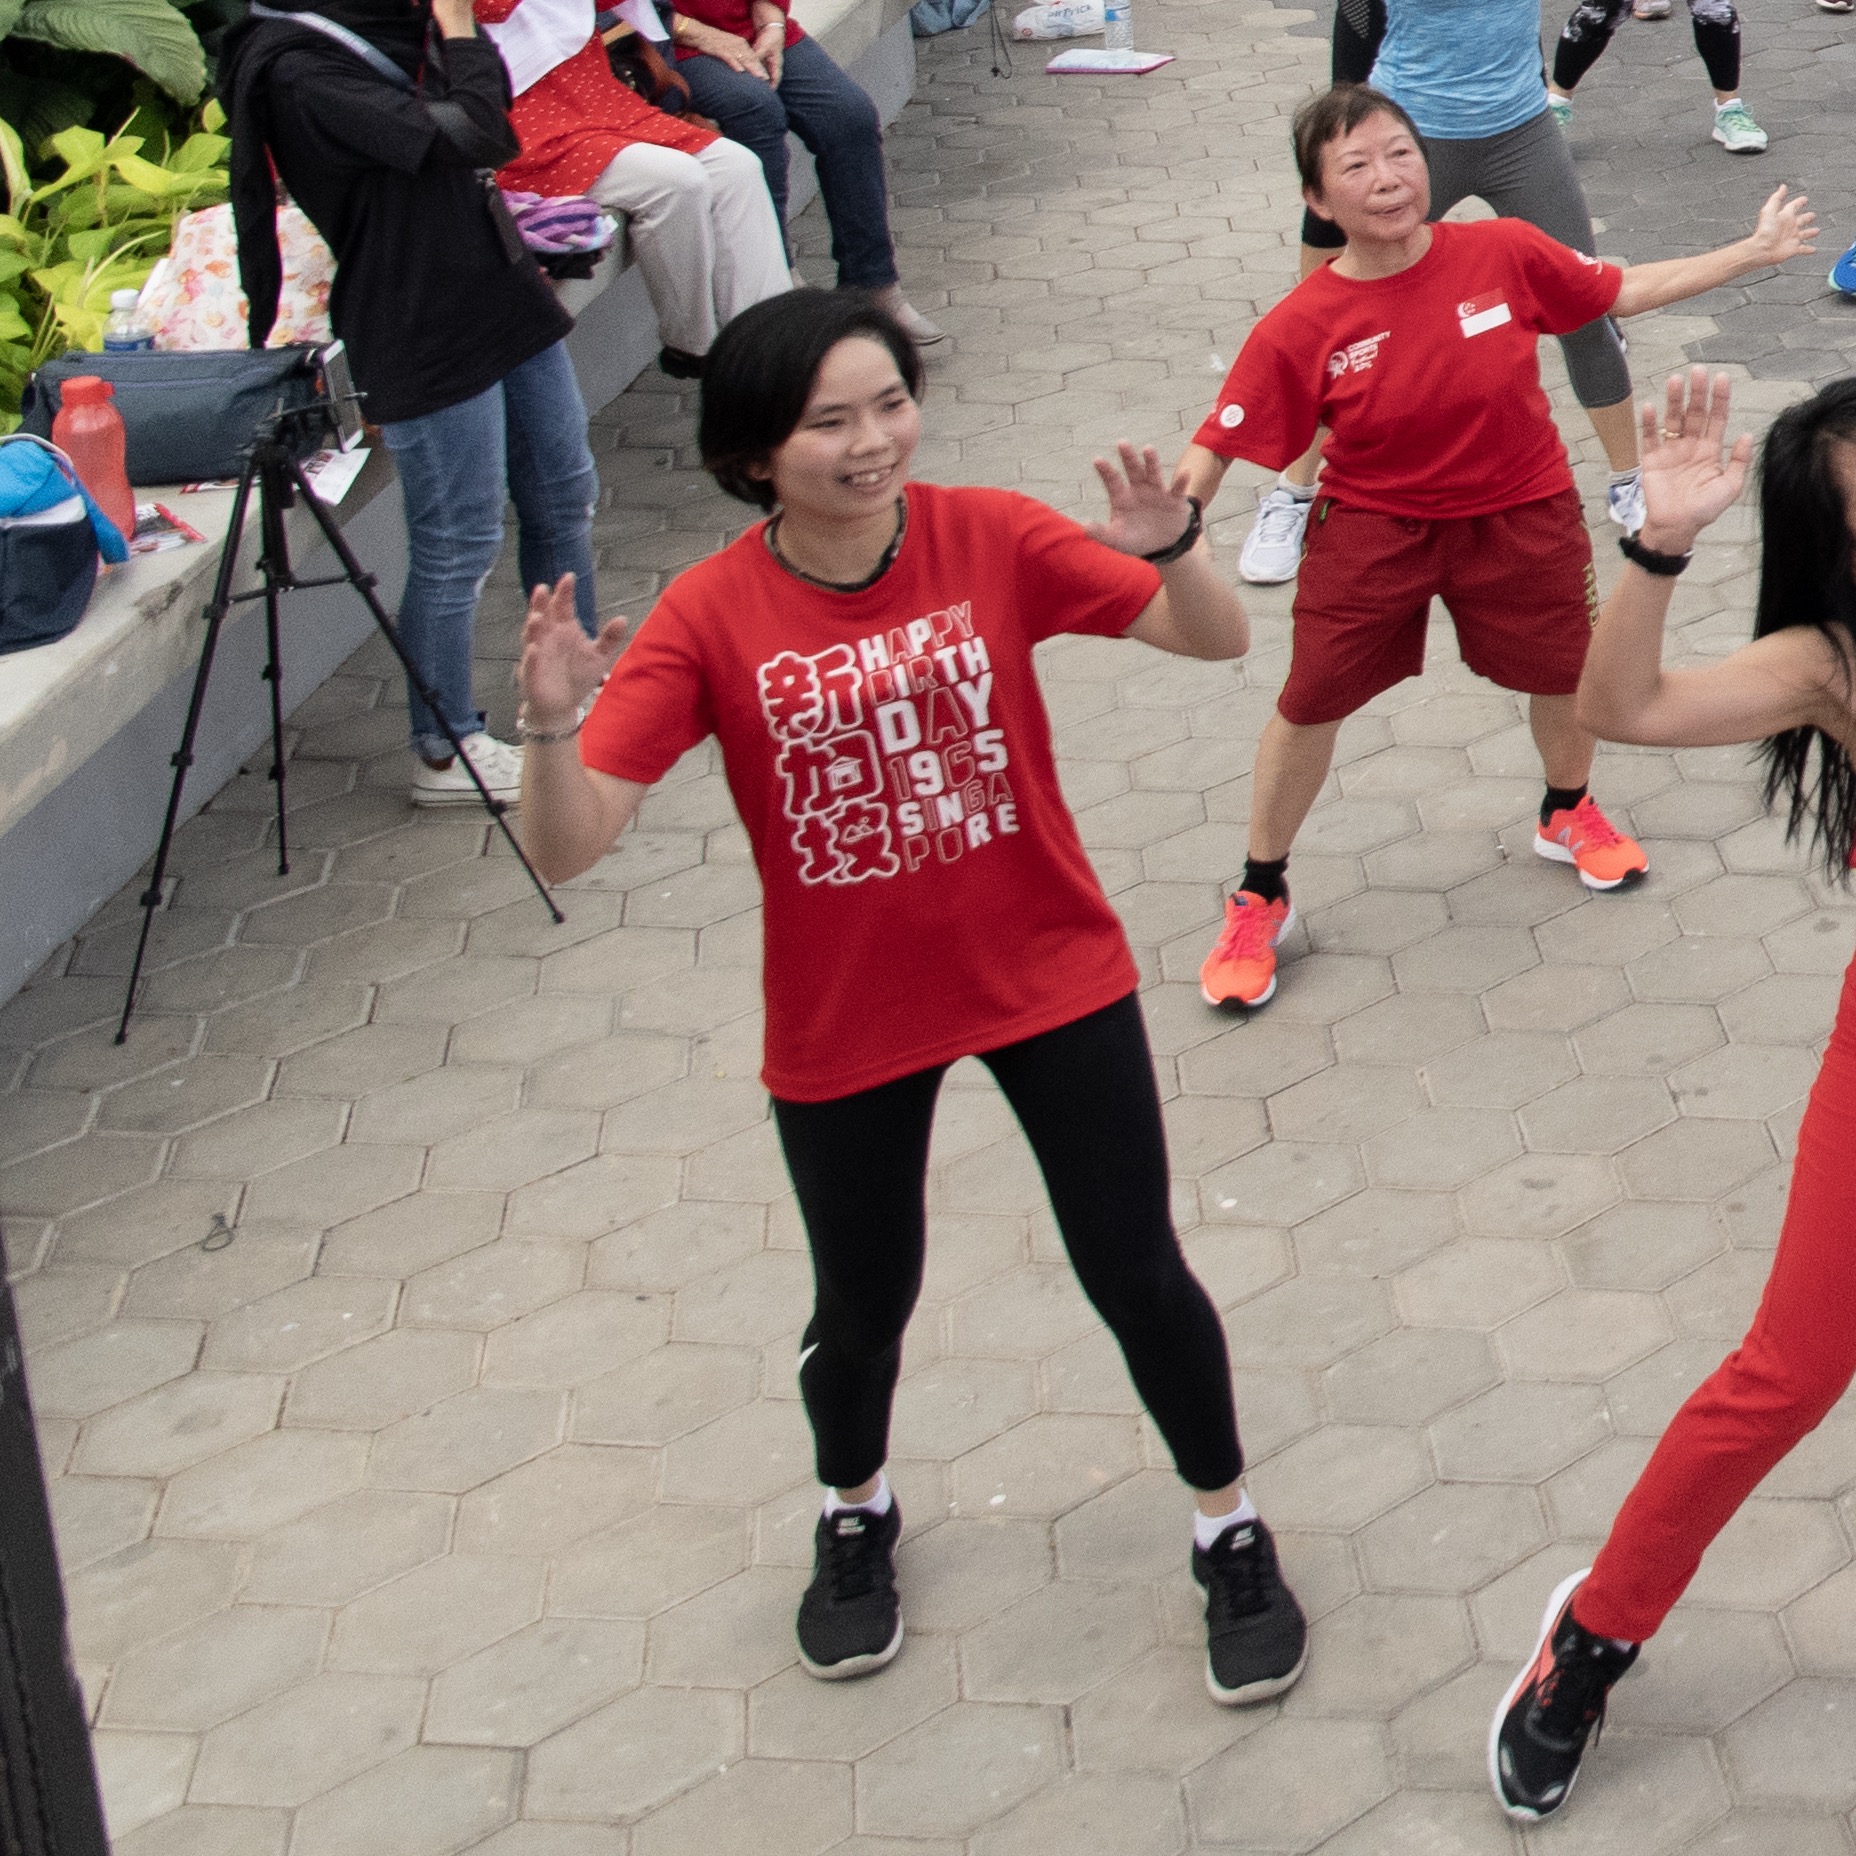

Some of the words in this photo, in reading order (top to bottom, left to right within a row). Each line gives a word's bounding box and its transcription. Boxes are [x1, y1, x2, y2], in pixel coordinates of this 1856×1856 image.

[857, 600, 975, 672] HAPPY
[867, 636, 992, 705] BIRTH
[875, 671, 994, 756] DAY
[887, 728, 1009, 801] 1965
[896, 772, 1014, 837] SINGA
[902, 802, 1021, 873] PORE
